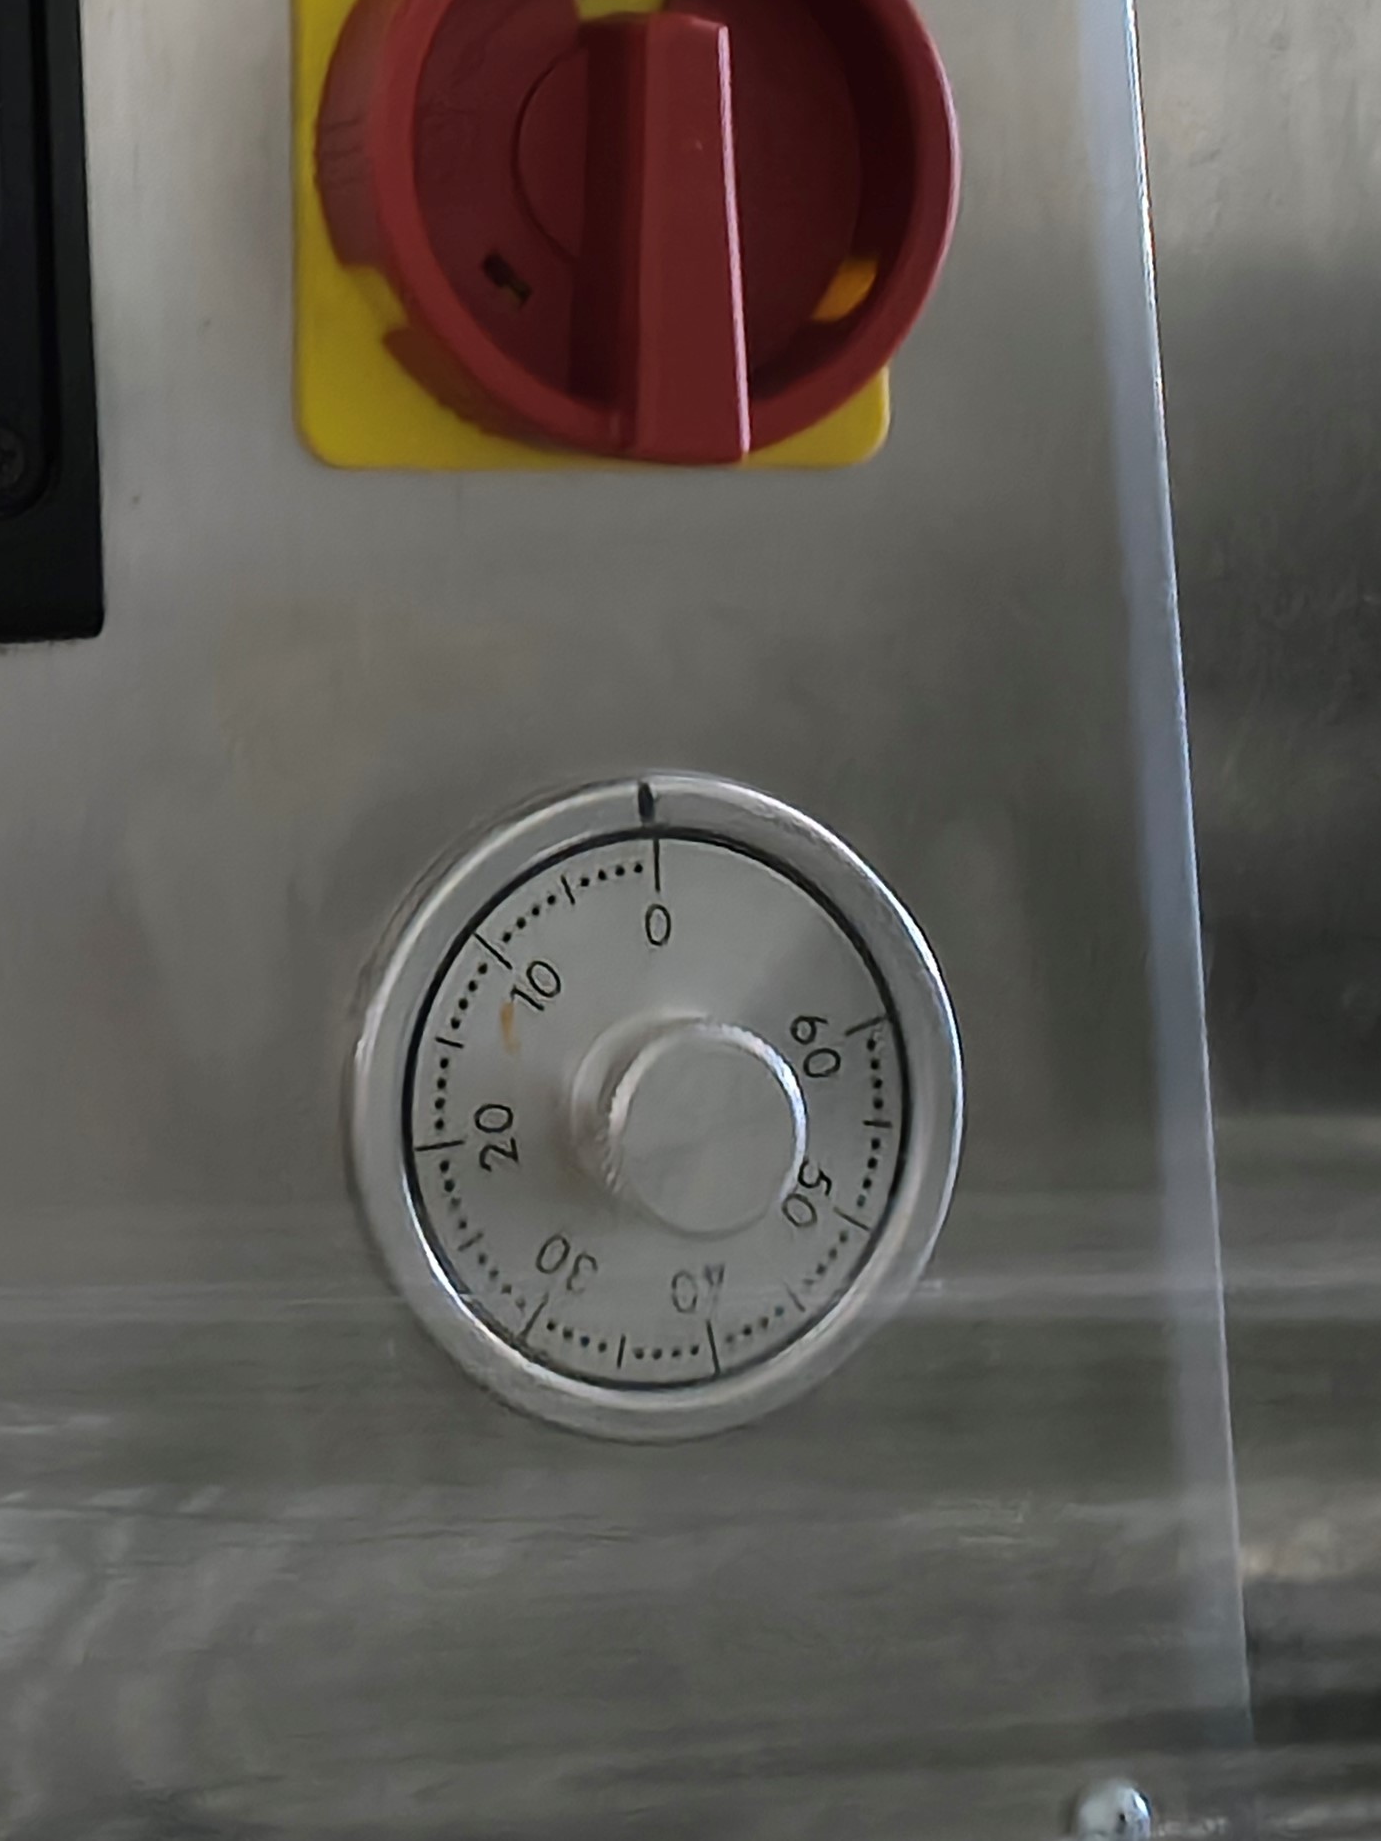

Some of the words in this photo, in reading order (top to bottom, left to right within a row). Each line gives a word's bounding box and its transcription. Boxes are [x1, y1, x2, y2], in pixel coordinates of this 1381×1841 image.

[644, 905, 671, 946] 0
[510, 959, 562, 1011] 10
[790, 1014, 841, 1079] 60
[474, 1103, 520, 1172] 20
[781, 1159, 832, 1227] 50
[536, 1235, 598, 1292] 30
